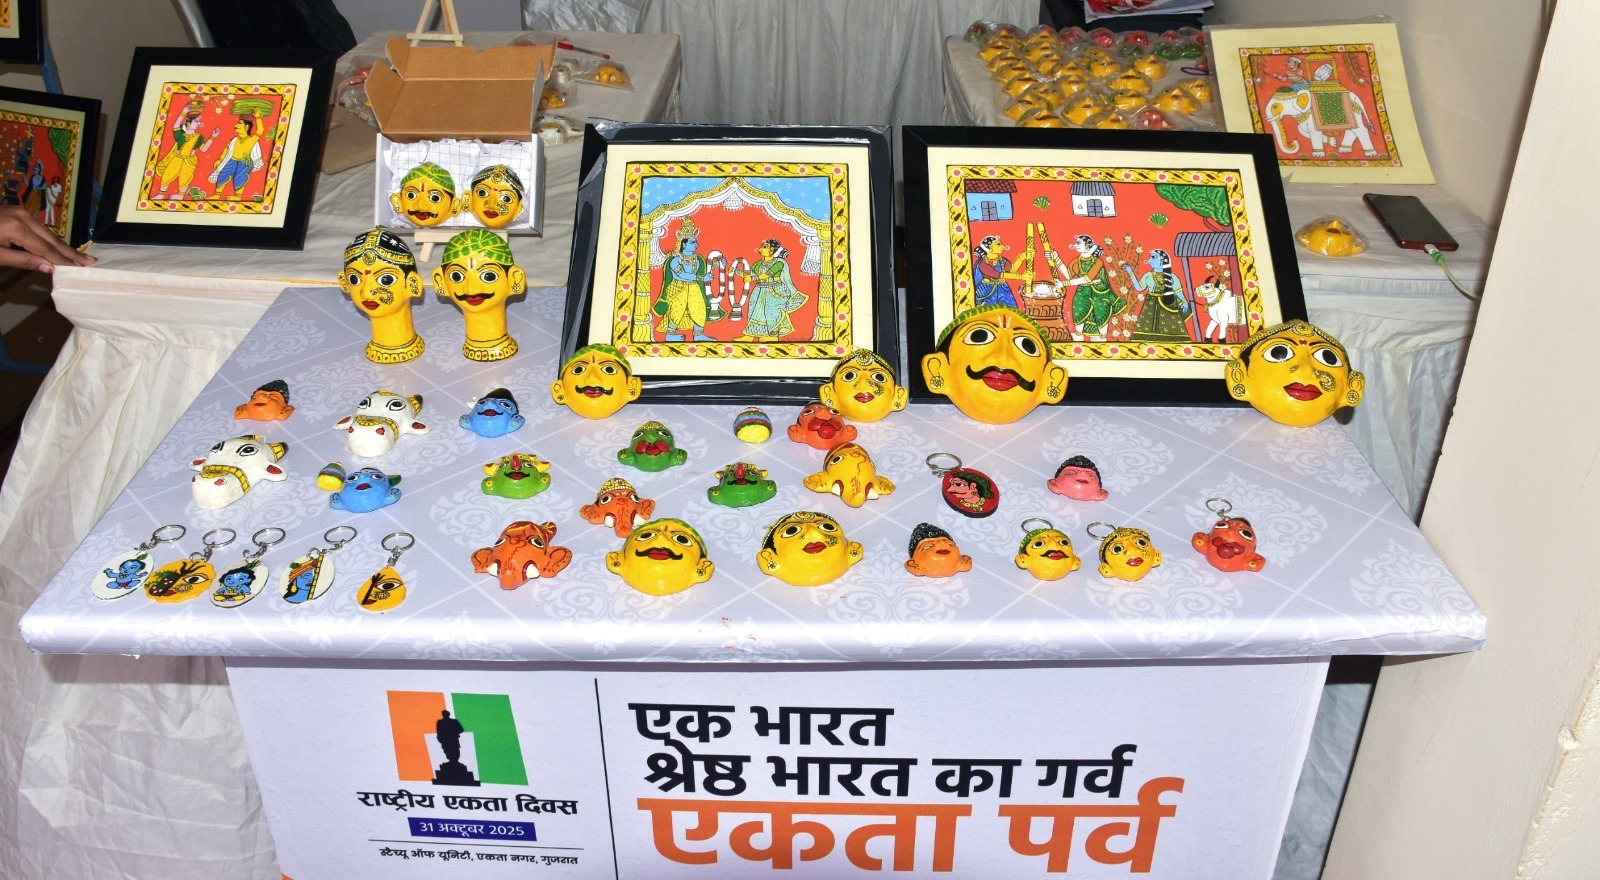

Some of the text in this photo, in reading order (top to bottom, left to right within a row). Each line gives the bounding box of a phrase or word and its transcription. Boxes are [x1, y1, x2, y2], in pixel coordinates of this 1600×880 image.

[627, 702, 895, 747] एक भारत
[643, 738, 1138, 799] श्रेष्ठ भारत का गर्व
[356, 789, 579, 816] राष्ट्रीय एकता दिवस
[419, 822, 525, 838] 31 अक्टूबर 2025
[637, 776, 1186, 873] एकता पर्व
[411, 848, 436, 859] ऑफ
[475, 852, 508, 863] एकता
[510, 854, 539, 865] नगर,
[541, 855, 579, 866] गुजरात
